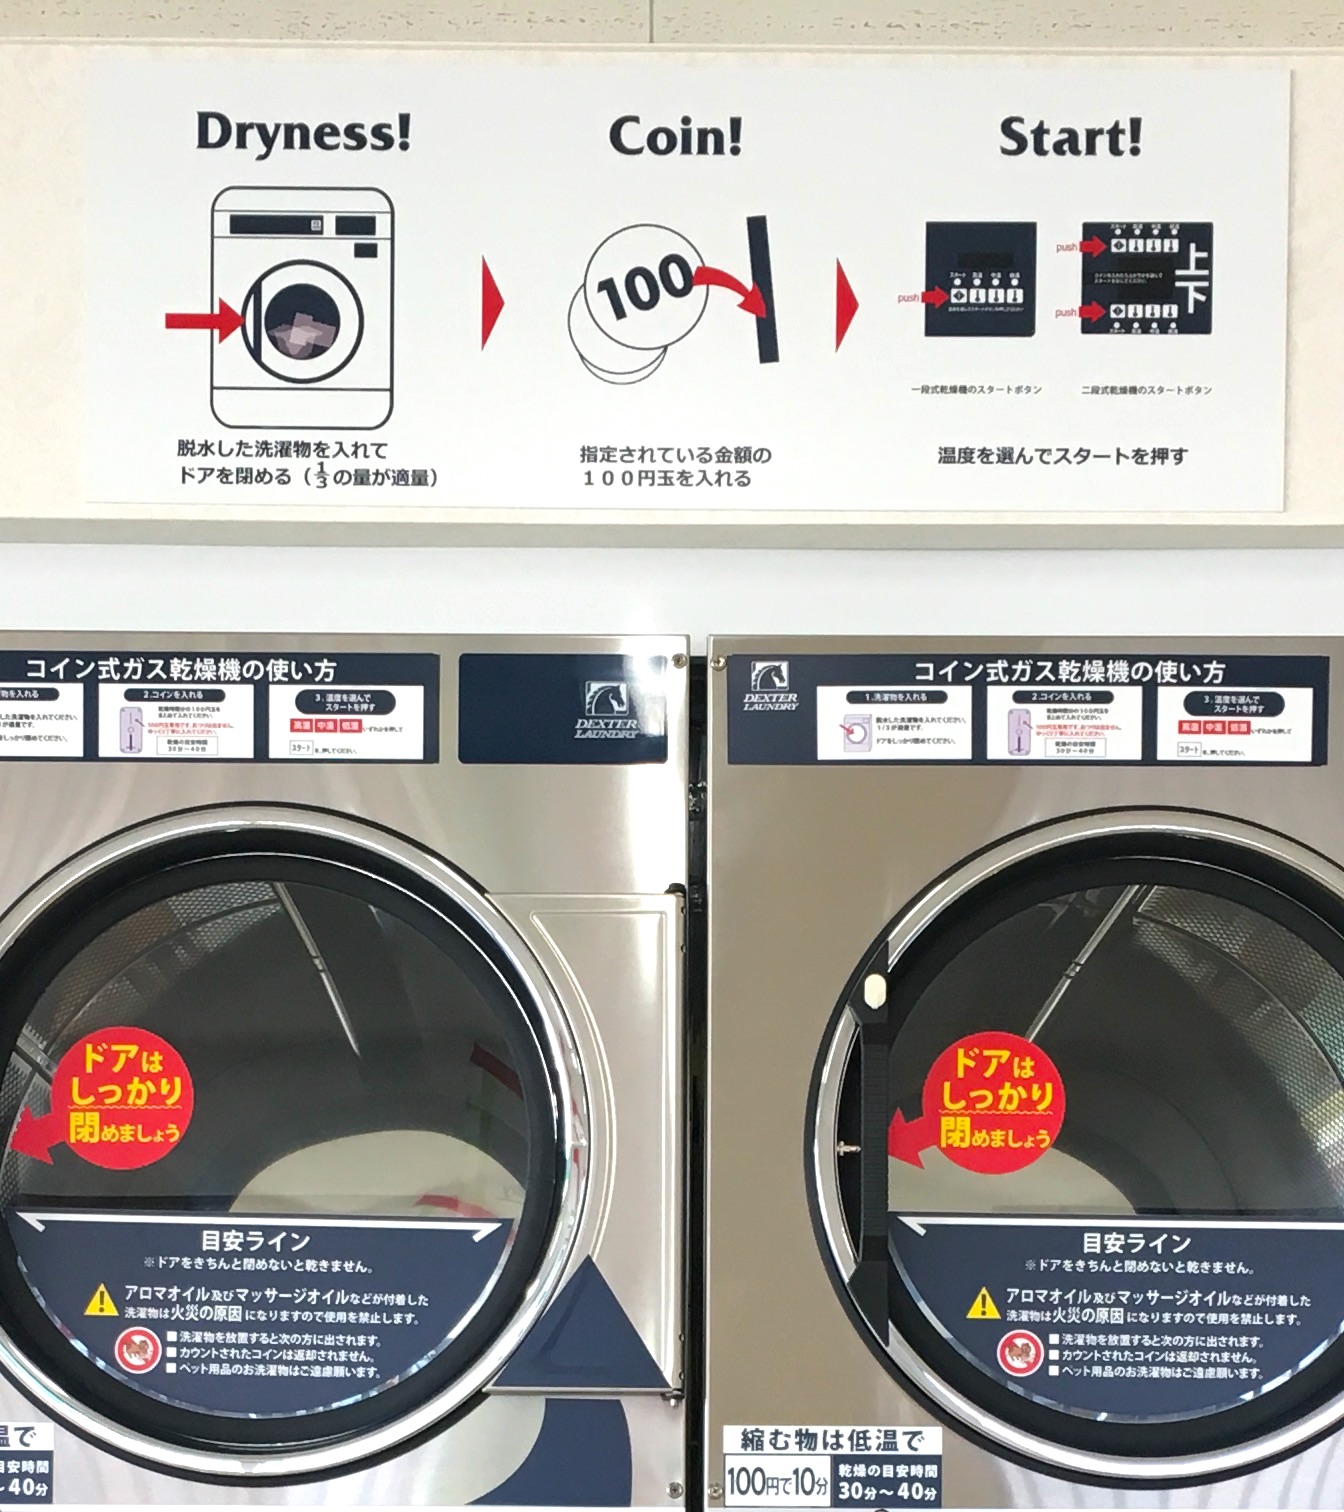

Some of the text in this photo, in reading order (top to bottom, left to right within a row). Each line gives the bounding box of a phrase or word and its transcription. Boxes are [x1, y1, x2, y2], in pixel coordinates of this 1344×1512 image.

[197, 111, 411, 160] Dryness!
[609, 116, 742, 156] Coin!
[1000, 117, 1142, 156] Start!
[1056, 243, 1077, 252] push
[1175, 243, 1209, 275] 上
[596, 254, 695, 320] 100
[898, 294, 919, 303] push
[1175, 282, 1209, 313] 下
[1056, 308, 1077, 317] push
[911, 385, 1042, 395] 一段式乾燥機のスタートボタン
[1082, 386, 1212, 396] 二段式乾燥機のスタートボタン
[177, 439, 388, 459] 脱水した洗濯物を入れて
[580, 445, 772, 465] 指定されている金額の
[938, 447, 1188, 466] 温度を選んでスタートを押す
[26, 657, 337, 682] コイン式ガス乾燥機の使い方
[915, 660, 1226, 684] コイン式ガス乾燥機の使い方
[84, 1044, 163, 1074] ドアは
[956, 1048, 1034, 1079] ドアは
[72, 1077, 182, 1106] しっかり
[942, 1082, 1053, 1110] しっかり
[70, 1112, 180, 1144] 閉めましょう
[941, 1116, 1050, 1149] 閉めましょう
[202, 1231, 311, 1252] 目安ライン
[1082, 1233, 1192, 1254] 目安ライン
[124, 1285, 429, 1308] アロマオイル及びマッサージオイルなどが付着した
[1006, 1287, 1311, 1309] アロマオイル及びマッサージオイルなどが付着した
[741, 1429, 925, 1454] 縮む物は低温で
[727, 1467, 829, 1497] 100円で10分
[838, 1463, 938, 1479] 乾燥の目安時間
[838, 1482, 937, 1501] 30分～40分
